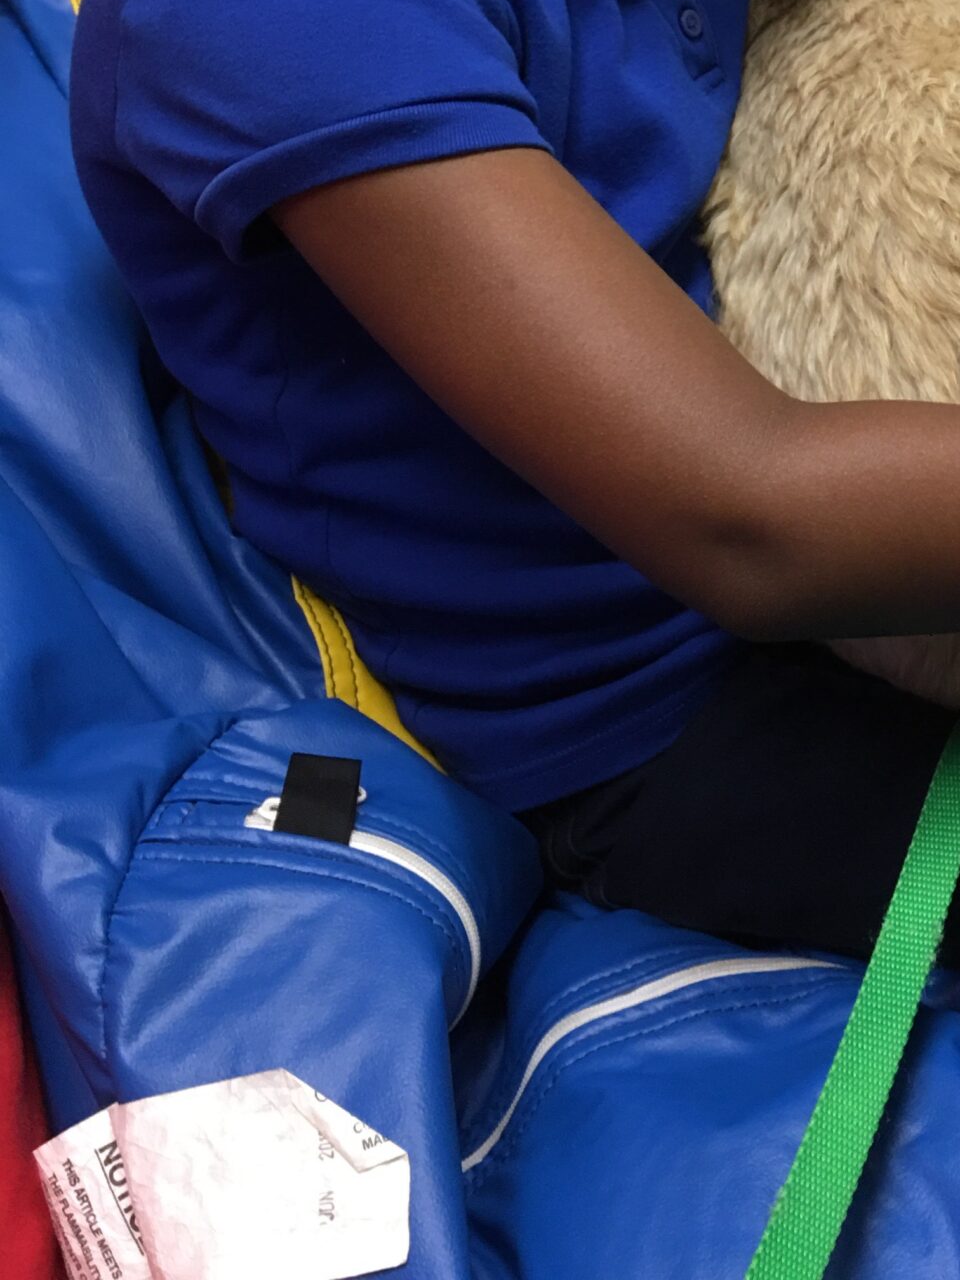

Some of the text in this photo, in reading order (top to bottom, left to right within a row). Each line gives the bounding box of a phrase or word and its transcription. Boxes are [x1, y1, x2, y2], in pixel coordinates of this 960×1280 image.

[48, 1173, 64, 1197] THE
[62, 1157, 123, 1280] THIS ARTICLE MEETS
[98, 1140, 144, 1246] NOIC
[318, 1191, 335, 1221] JUN
